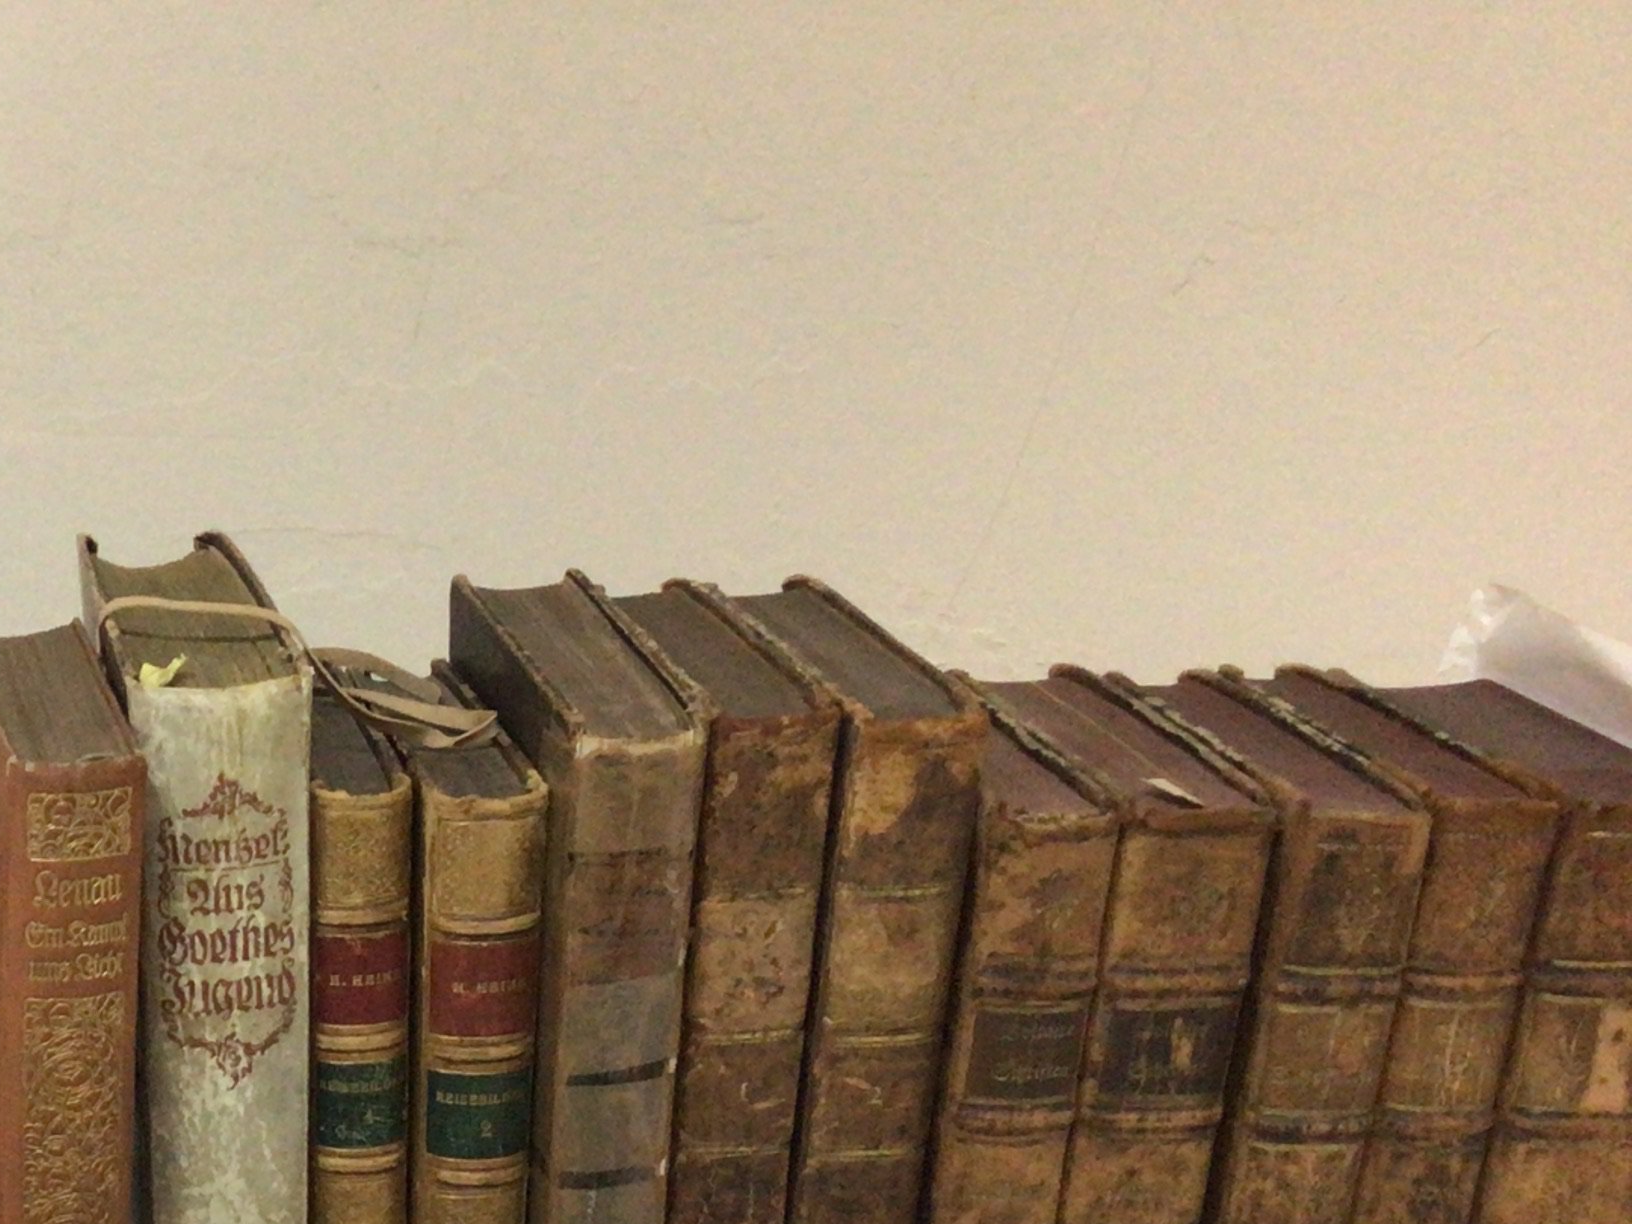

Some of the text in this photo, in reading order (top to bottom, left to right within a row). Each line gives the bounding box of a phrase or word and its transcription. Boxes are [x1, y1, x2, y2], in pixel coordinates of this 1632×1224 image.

[32, 870, 123, 908] Lenau
[187, 875, 265, 917] Aus
[158, 914, 295, 966] Goethes
[161, 957, 296, 1020] Jugend
